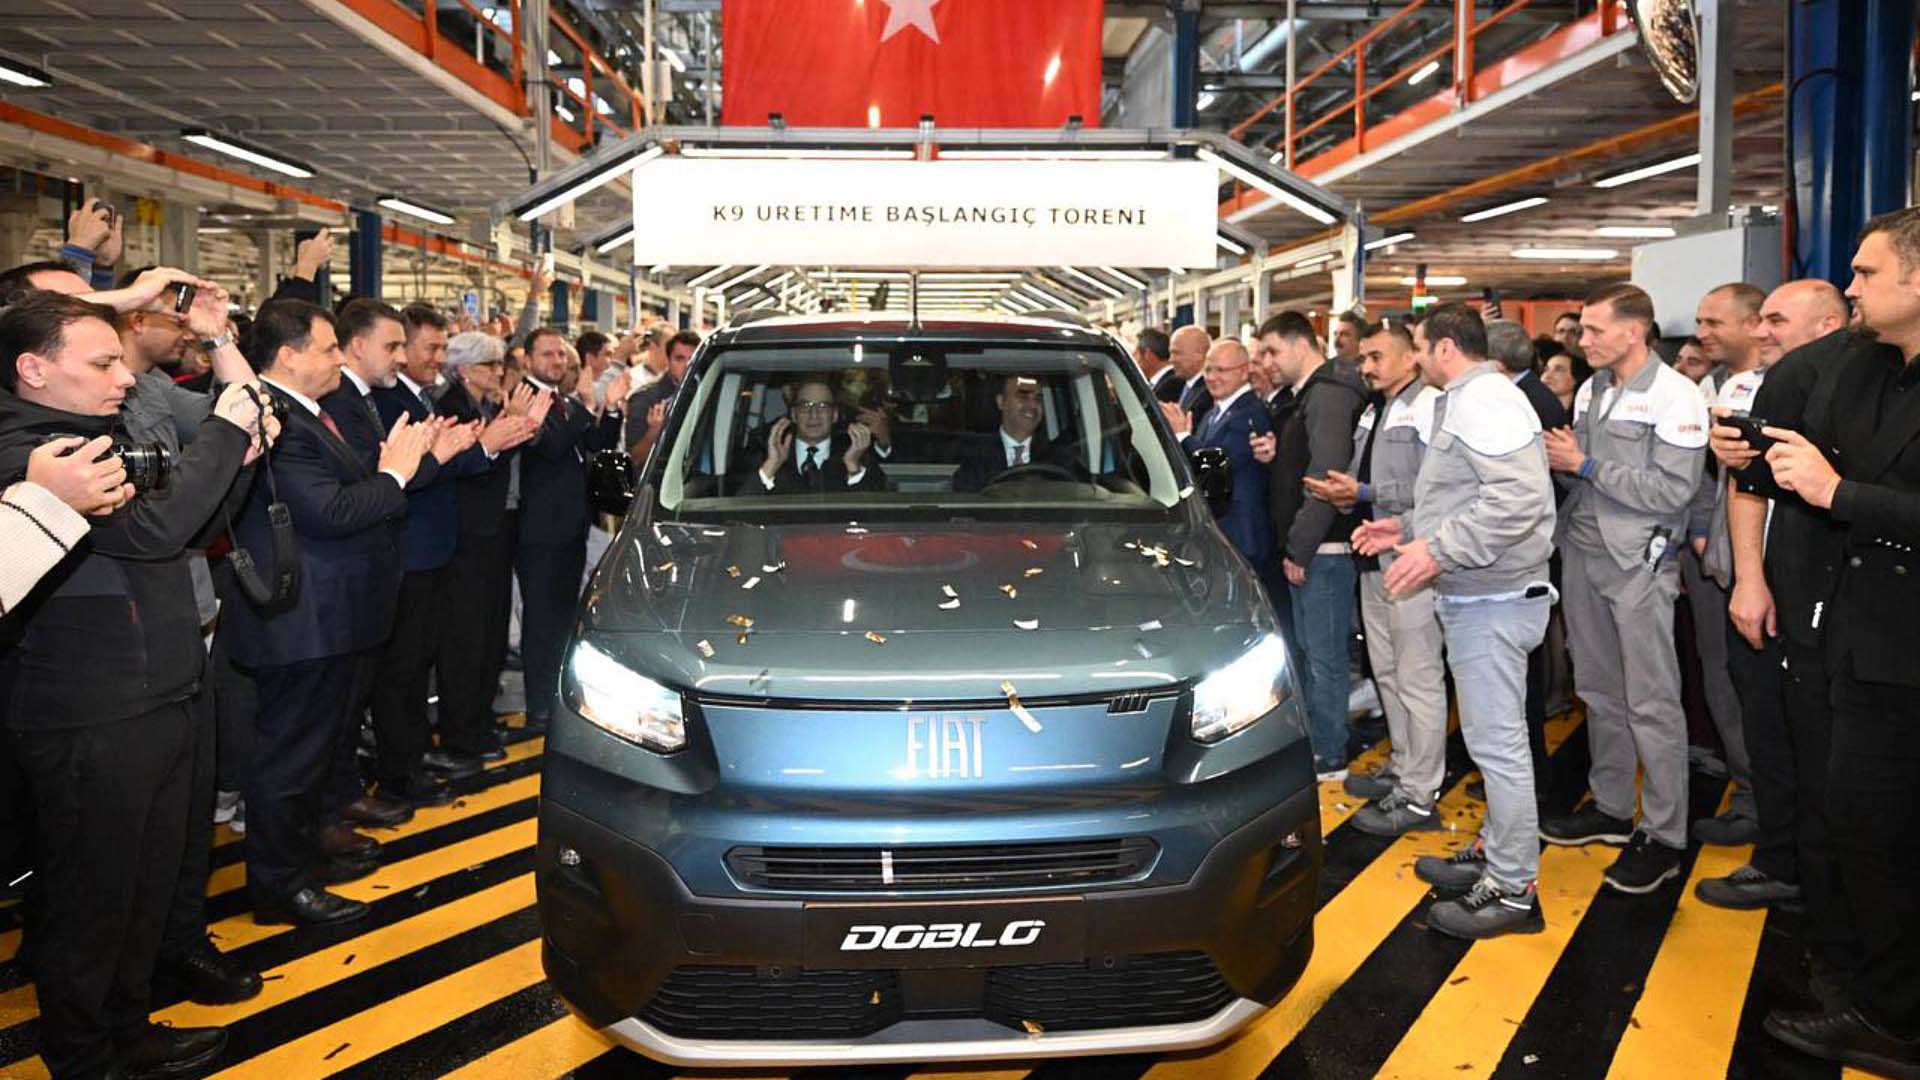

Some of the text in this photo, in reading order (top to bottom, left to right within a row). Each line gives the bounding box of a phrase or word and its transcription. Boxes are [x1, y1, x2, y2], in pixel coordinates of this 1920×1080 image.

[713, 205, 744, 222] K9
[886, 206, 1036, 228] BAŞLANGIÇ
[906, 716, 987, 780] FIAT
